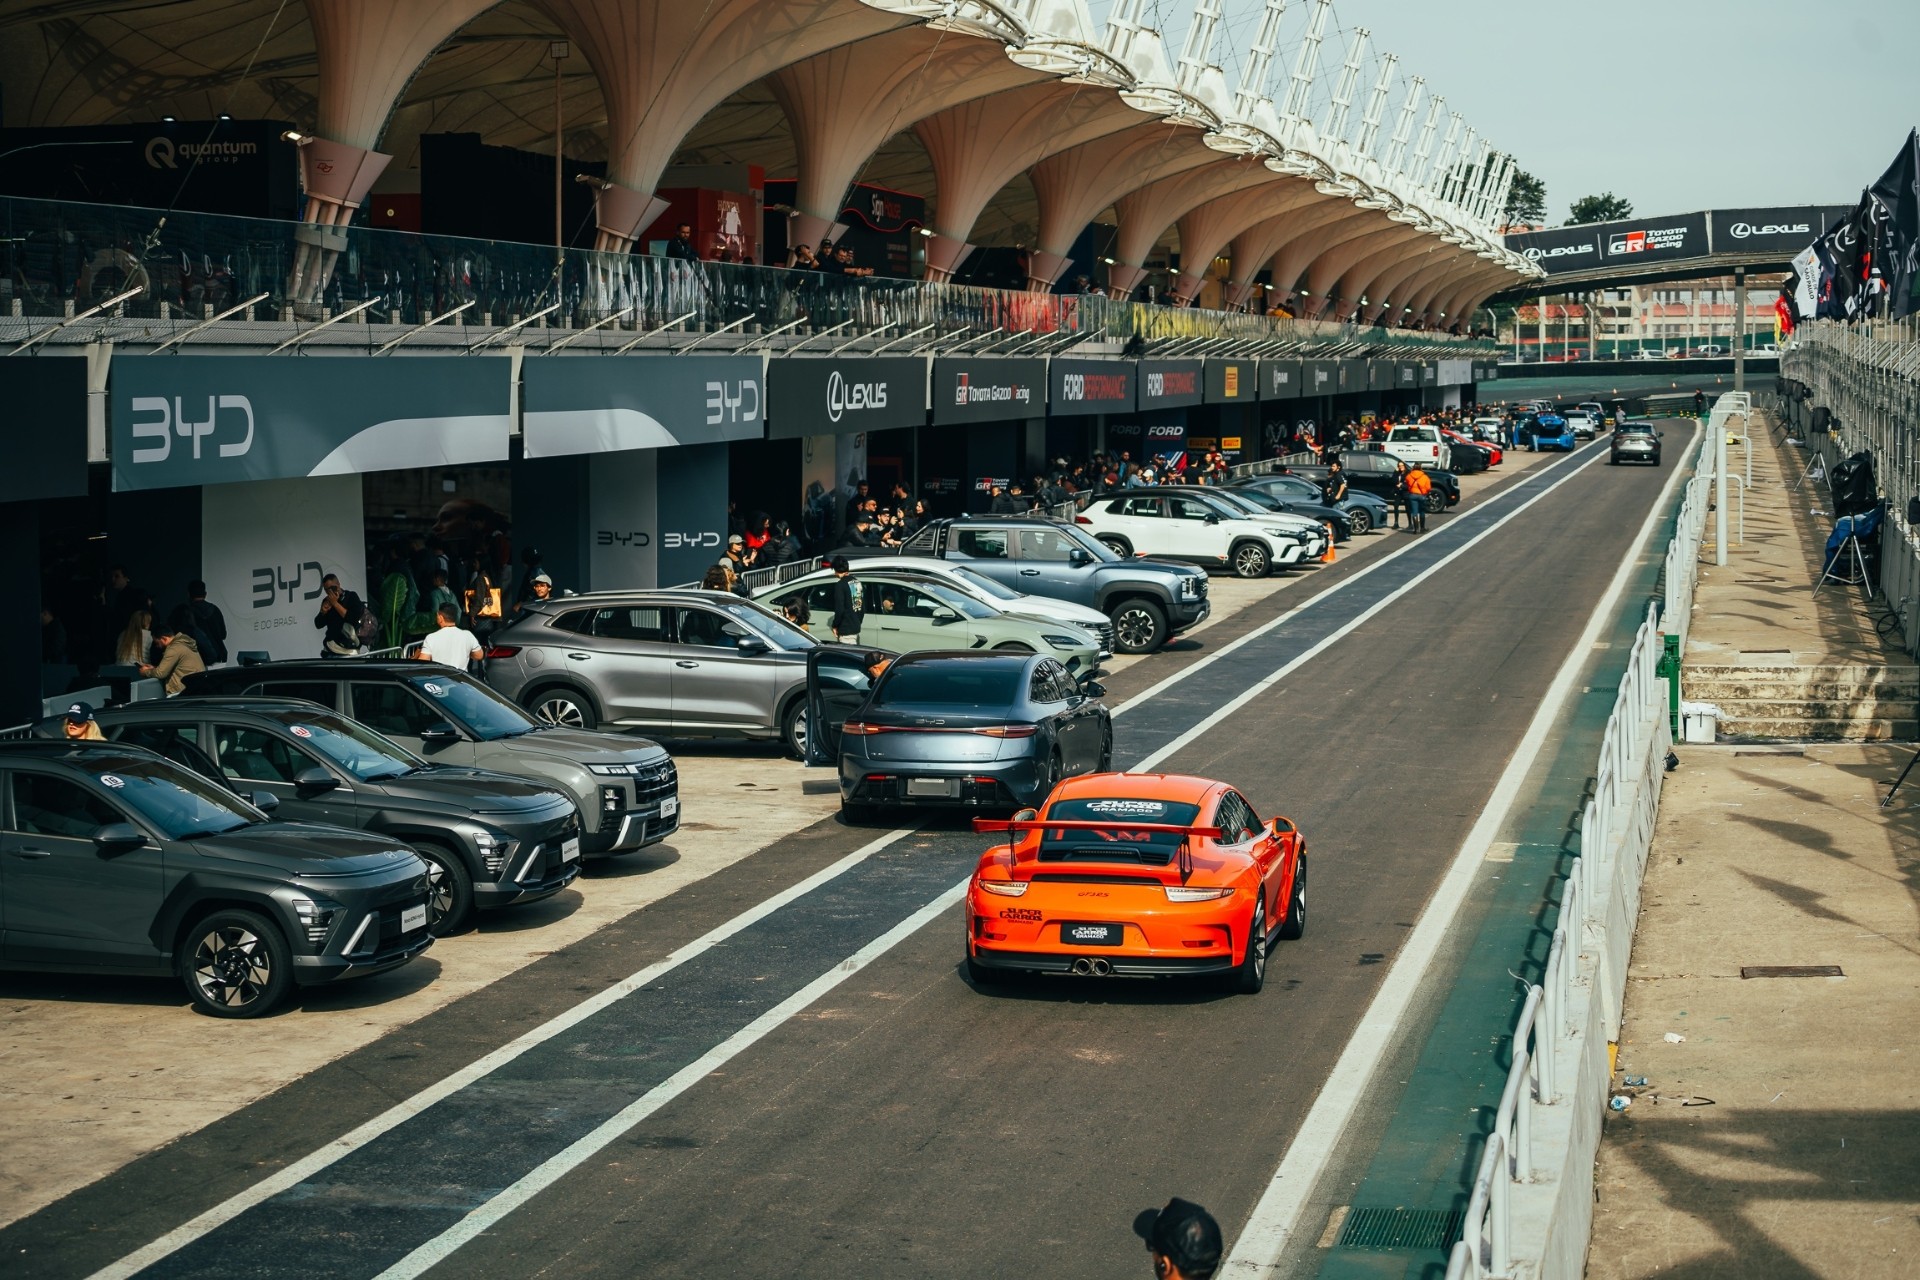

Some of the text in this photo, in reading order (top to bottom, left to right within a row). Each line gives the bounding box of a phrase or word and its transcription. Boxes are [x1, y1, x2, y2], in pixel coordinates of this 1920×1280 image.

[179, 141, 257, 159] quantum
[196, 156, 239, 165] group
[1647, 227, 1688, 237] TOYOTA
[1751, 223, 1810, 235] LEXUS
[1646, 234, 1684, 243] GAZOO
[1646, 240, 1683, 250] Racing
[1542, 243, 1594, 258] LEXUS
[1063, 374, 1084, 401] FORD
[1147, 372, 1164, 397] FORD
[706, 379, 759, 425] BYD
[844, 382, 887, 410] LEXUS
[968, 385, 991, 402] TOYOTA
[991, 384, 1012, 401] GAZOO
[1011, 383, 1030, 404] Racing
[132, 394, 255, 464] BYD
[1148, 426, 1184, 436] FORD
[597, 530, 650, 547] BYD
[664, 531, 721, 548] BYD
[252, 561, 324, 609] BYD
[1000, 910, 1043, 922] CARROS
[1007, 907, 1042, 916] SUPER
